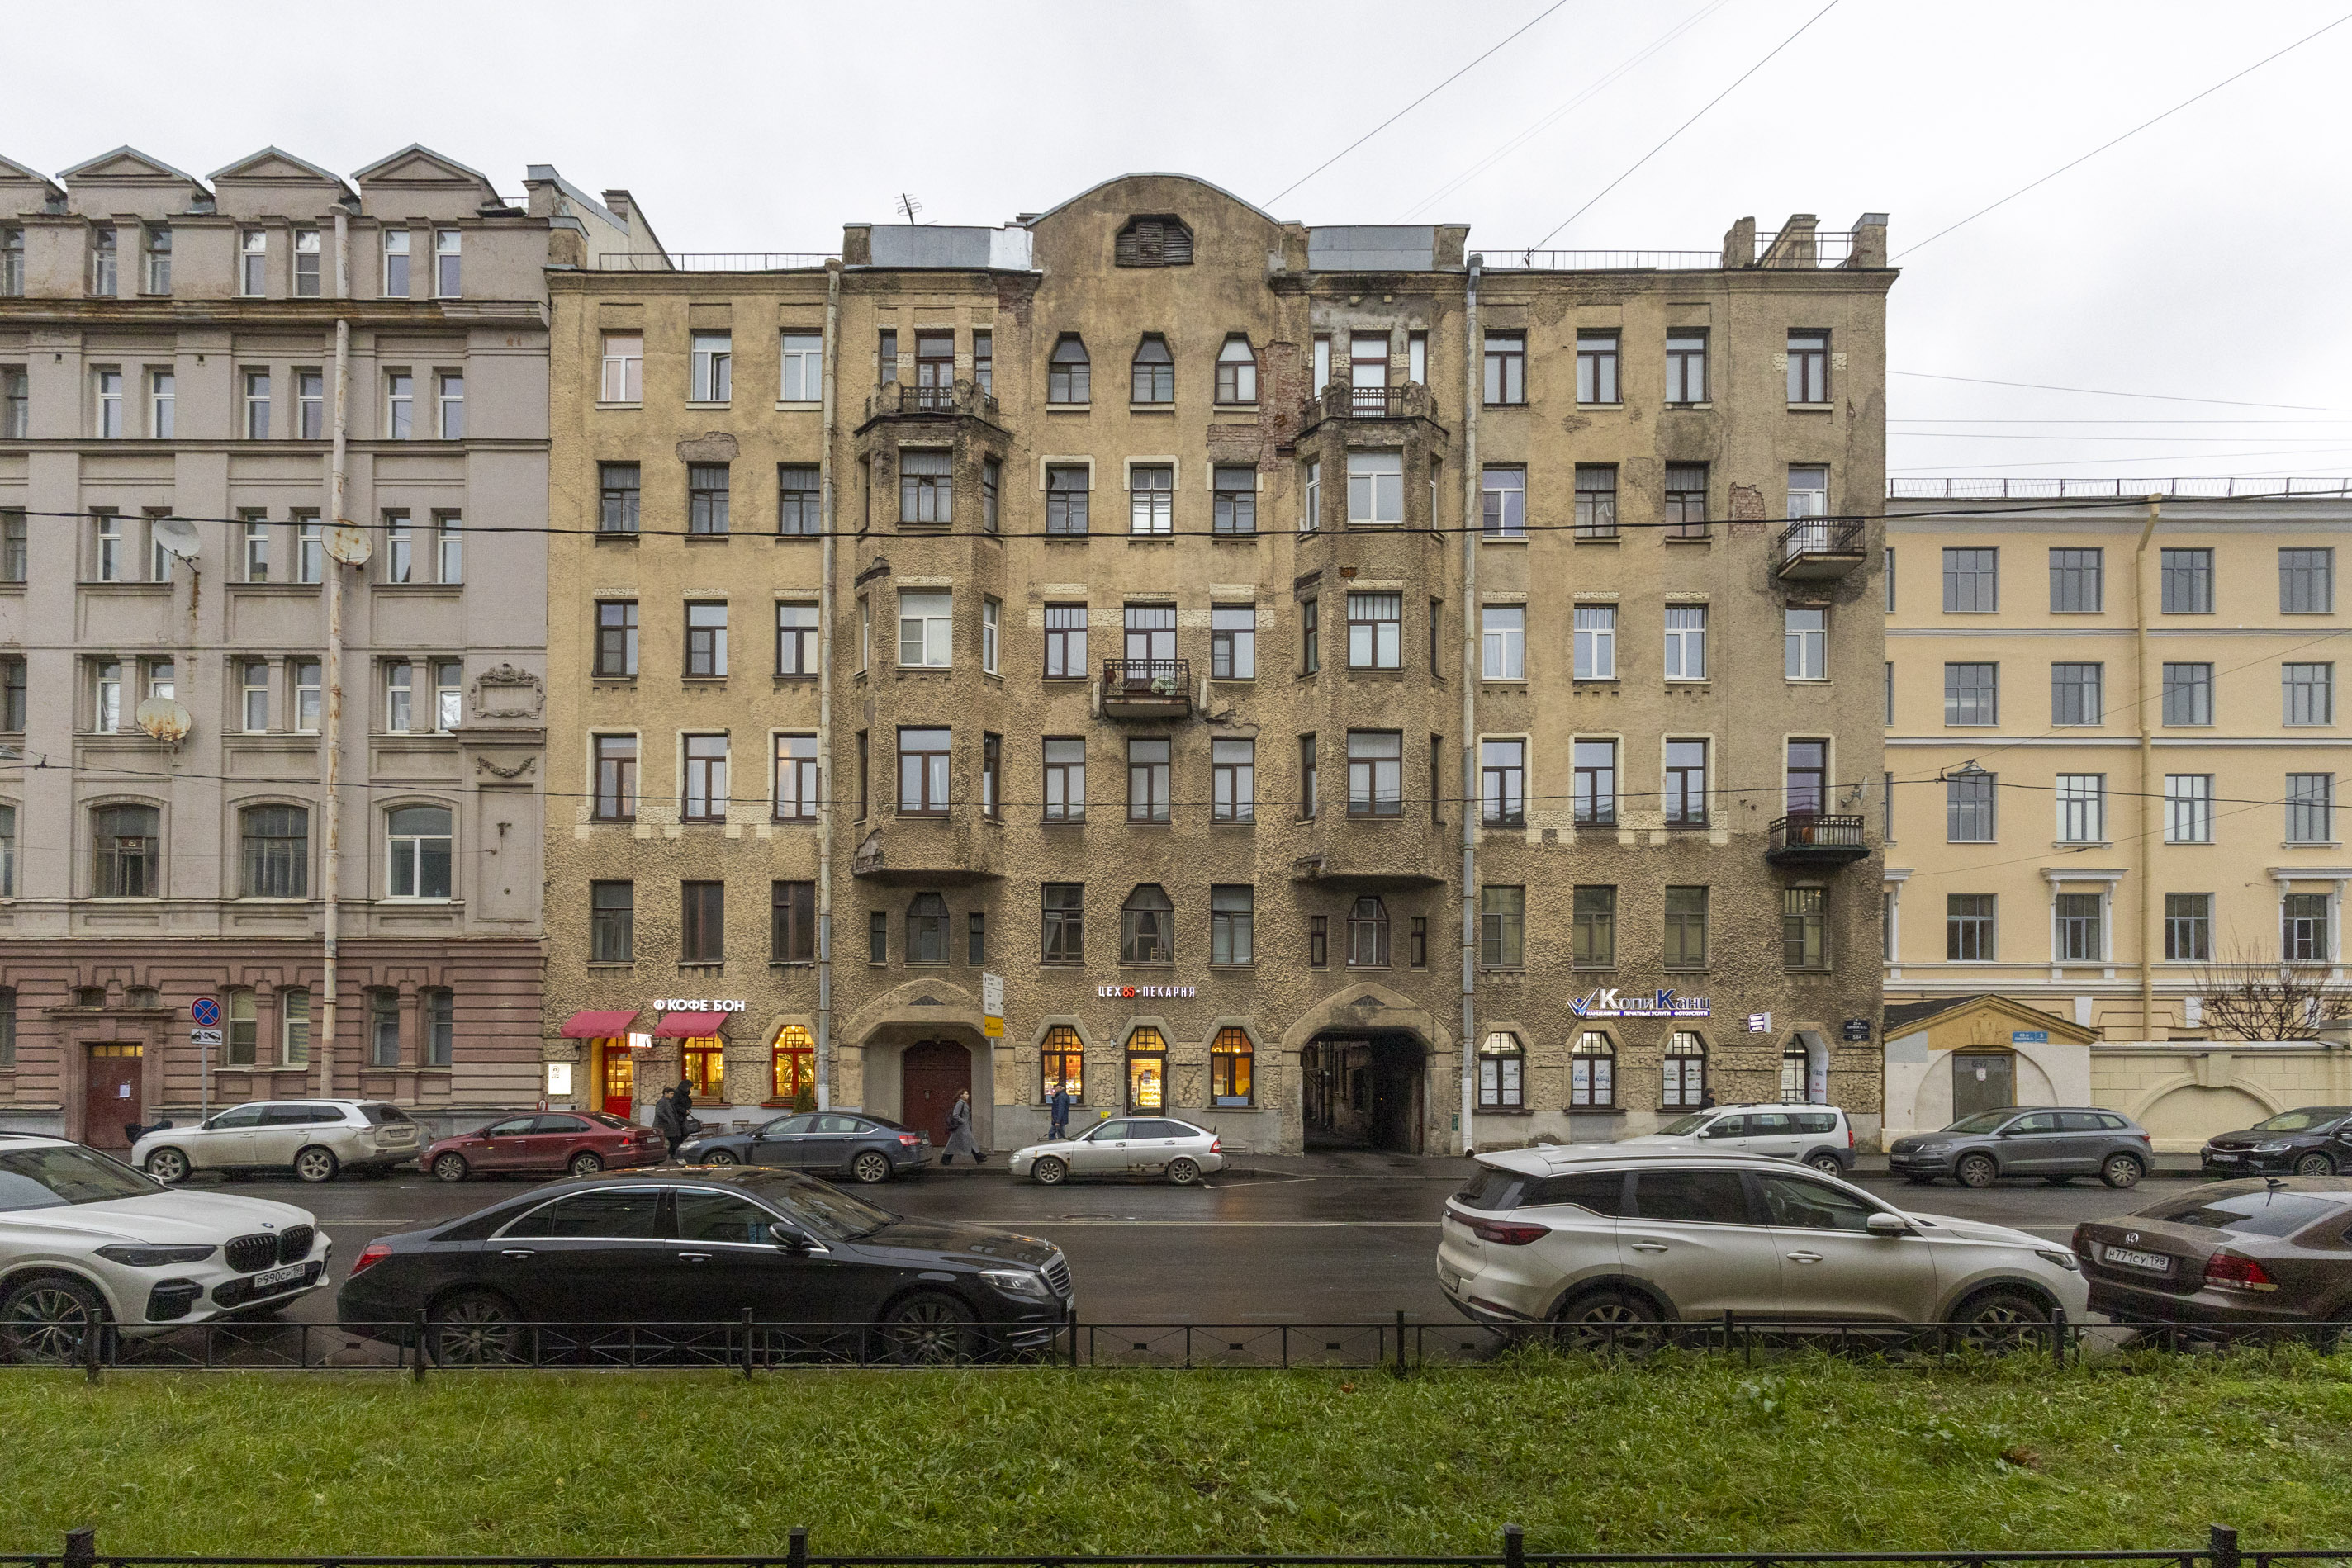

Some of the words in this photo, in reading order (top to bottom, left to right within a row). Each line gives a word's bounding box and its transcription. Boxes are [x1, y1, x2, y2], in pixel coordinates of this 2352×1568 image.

[1143, 986, 1195, 997] ПЕКАРНЯ
[667, 999, 708, 1011] КОФЕ
[714, 1000, 745, 1011] БОН
[2108, 1249, 2146, 1264] Н771СУ
[2149, 1255, 2165, 1265] 198
[257, 1272, 291, 1286] Р990СР
